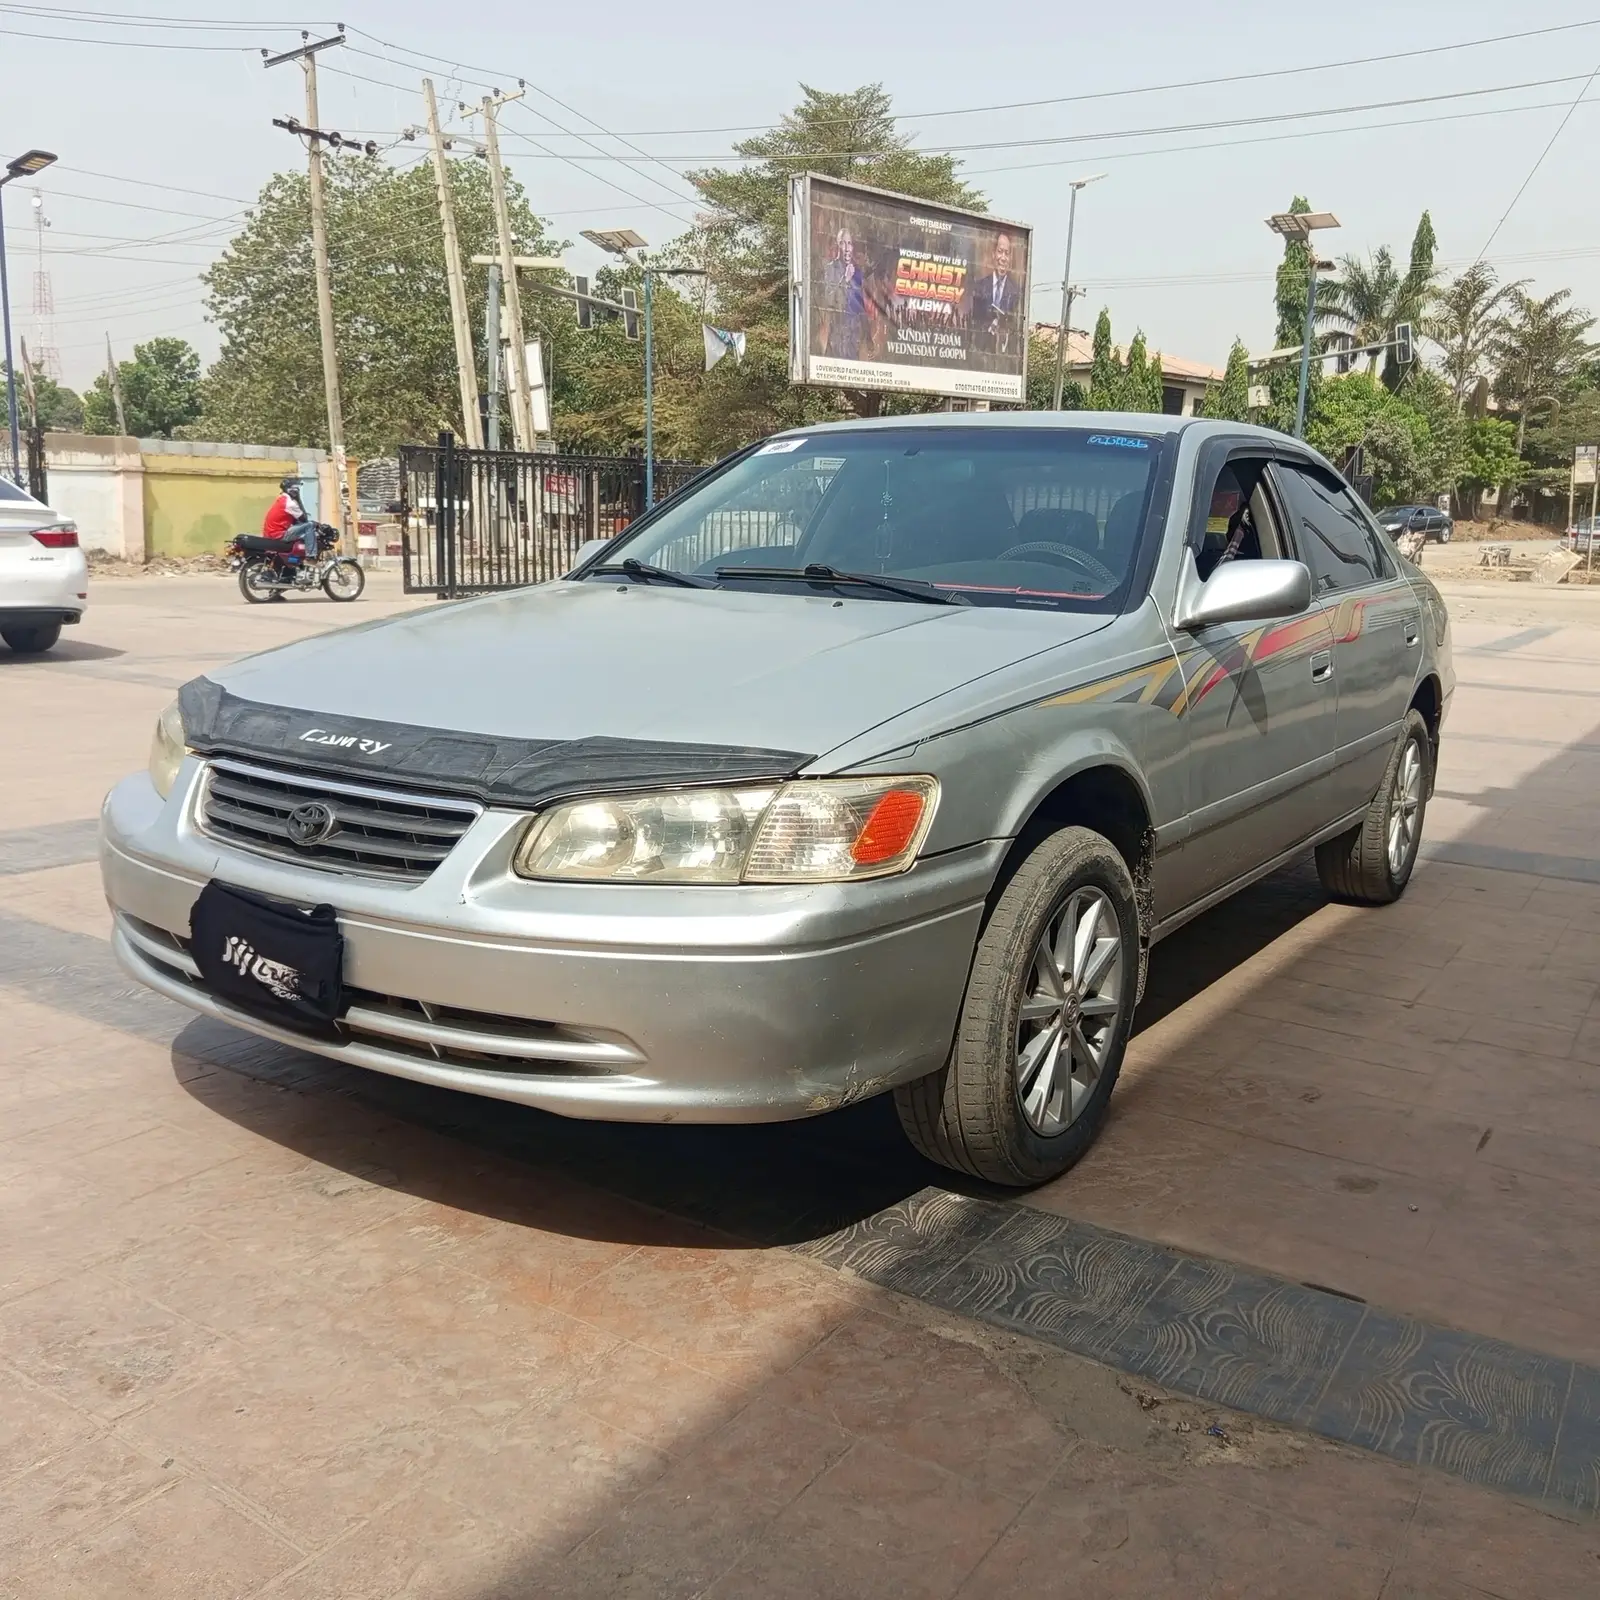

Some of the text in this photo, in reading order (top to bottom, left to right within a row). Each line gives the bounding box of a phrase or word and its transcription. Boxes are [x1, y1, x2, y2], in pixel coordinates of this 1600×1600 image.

[899, 248, 932, 261] WORSHIP
[932, 254, 951, 264] WITH
[896, 257, 967, 286] CHRIST
[894, 278, 965, 304] EMBASSY
[907, 297, 953, 315] KUBWA
[897, 328, 931, 345] SUNDAY
[887, 340, 938, 358] WEDNESDAY
[299, 728, 393, 755] CAMRY
